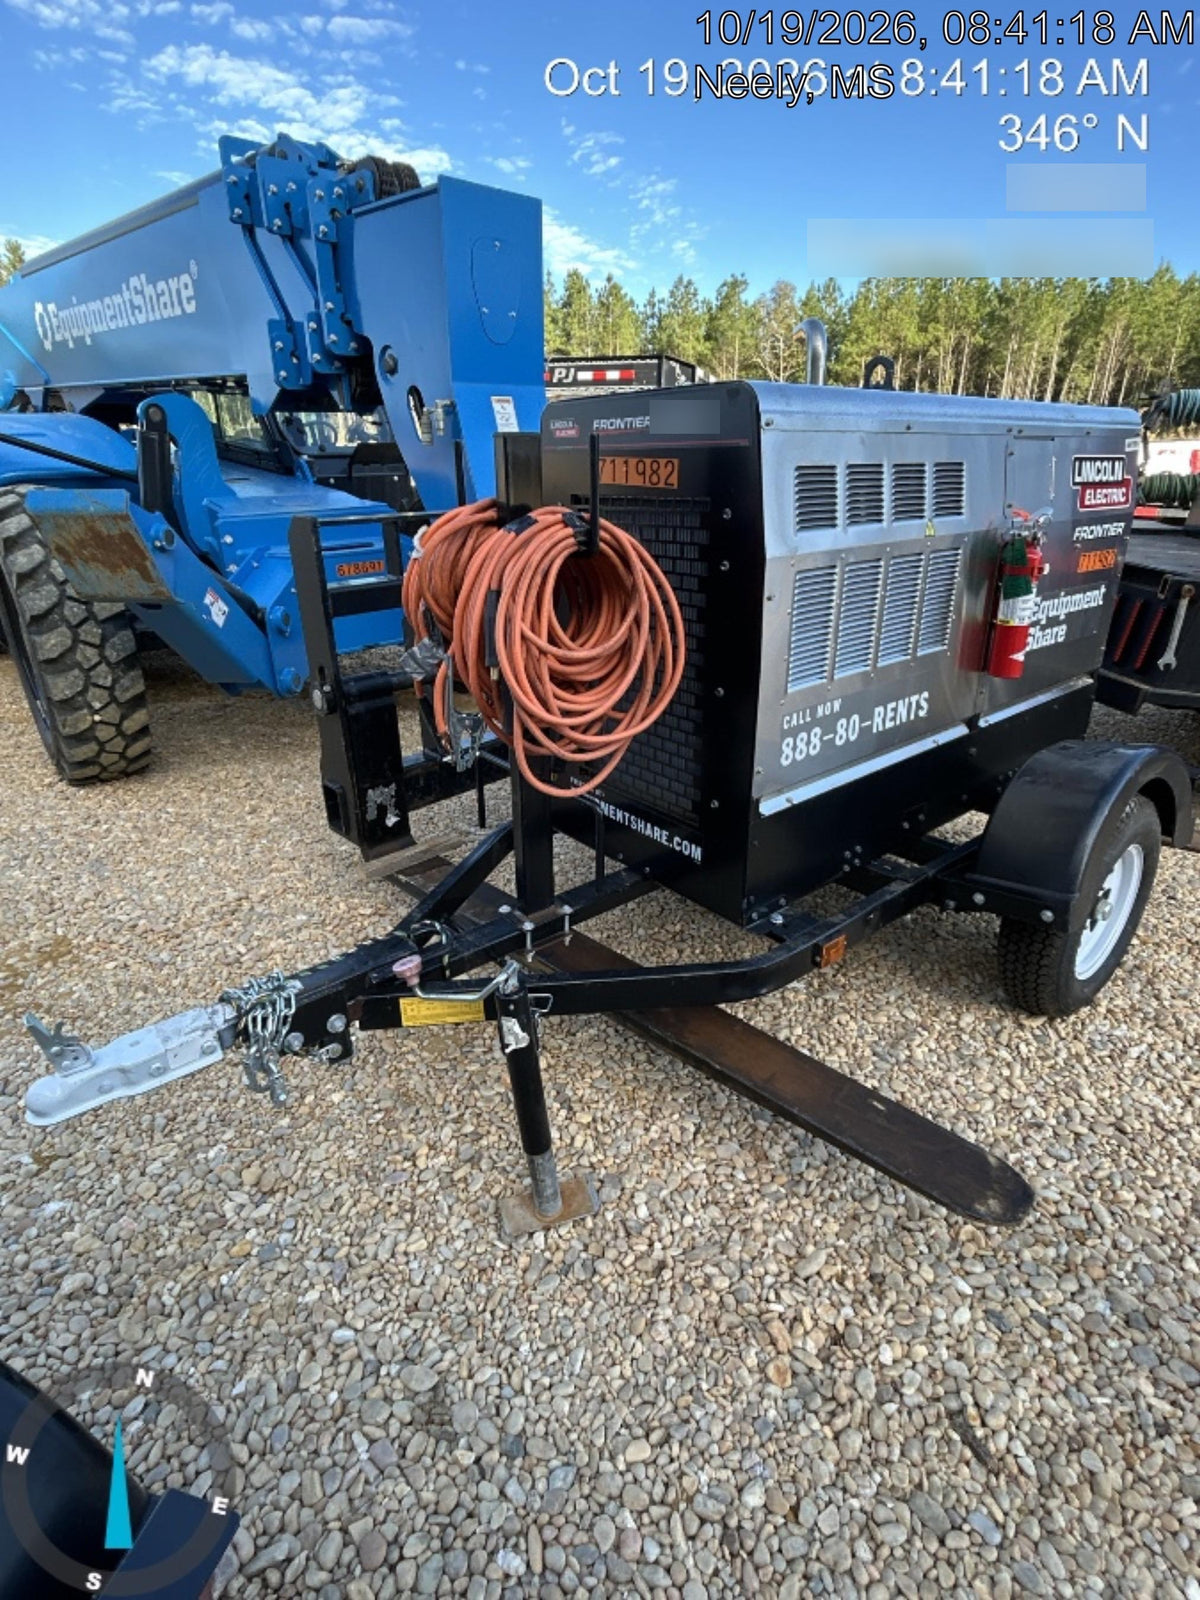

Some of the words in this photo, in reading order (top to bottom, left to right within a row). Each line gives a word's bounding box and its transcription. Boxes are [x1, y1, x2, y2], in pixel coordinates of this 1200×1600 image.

[552, 367, 575, 383] PJ
[1074, 460, 1124, 482] LINCOLN
[1084, 487, 1127, 505] ELECTRIC
[1073, 522, 1125, 541] FRONTIER
[1031, 584, 1106, 624] Equipment
[783, 708, 812, 730] CALL
[816, 697, 842, 719] NOW
[780, 691, 929, 766] 888-80-RENTS
